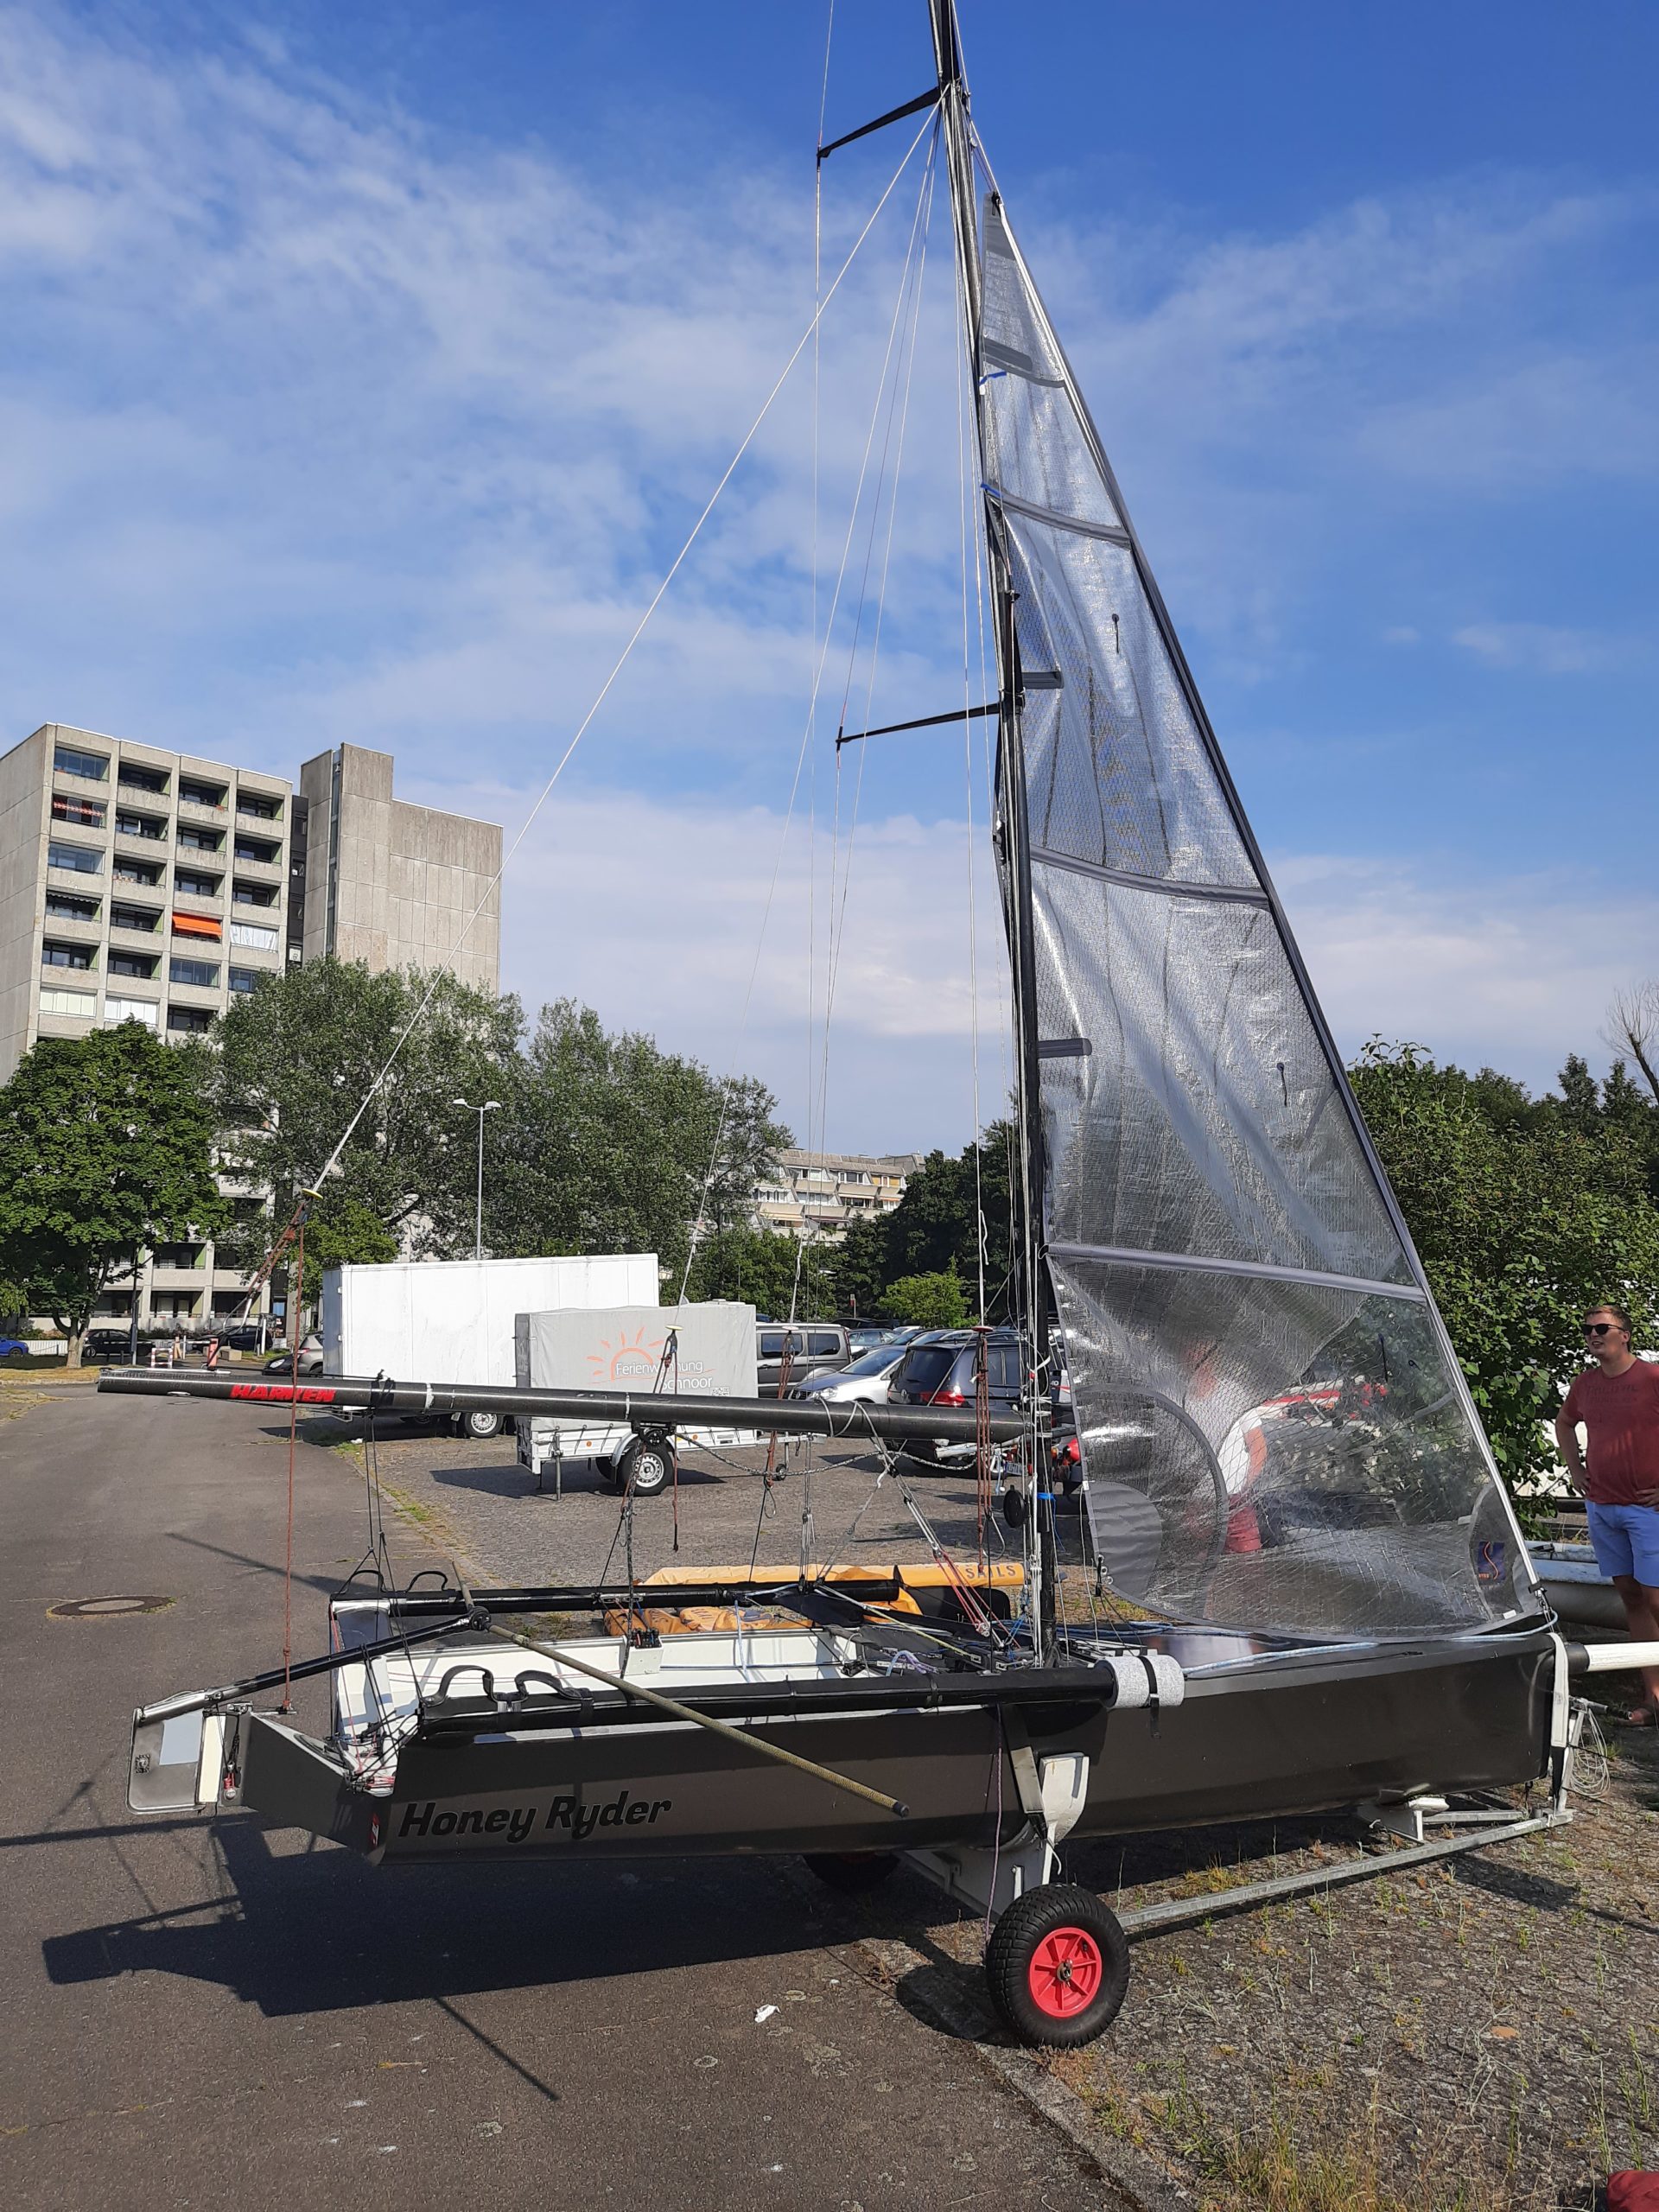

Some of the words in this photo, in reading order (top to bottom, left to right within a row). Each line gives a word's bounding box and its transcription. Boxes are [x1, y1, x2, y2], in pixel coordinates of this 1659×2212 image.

[615, 1360, 704, 1376] Ferienwhnung
[397, 1802, 537, 1844] Honey
[544, 1790, 672, 1840] Ryder
